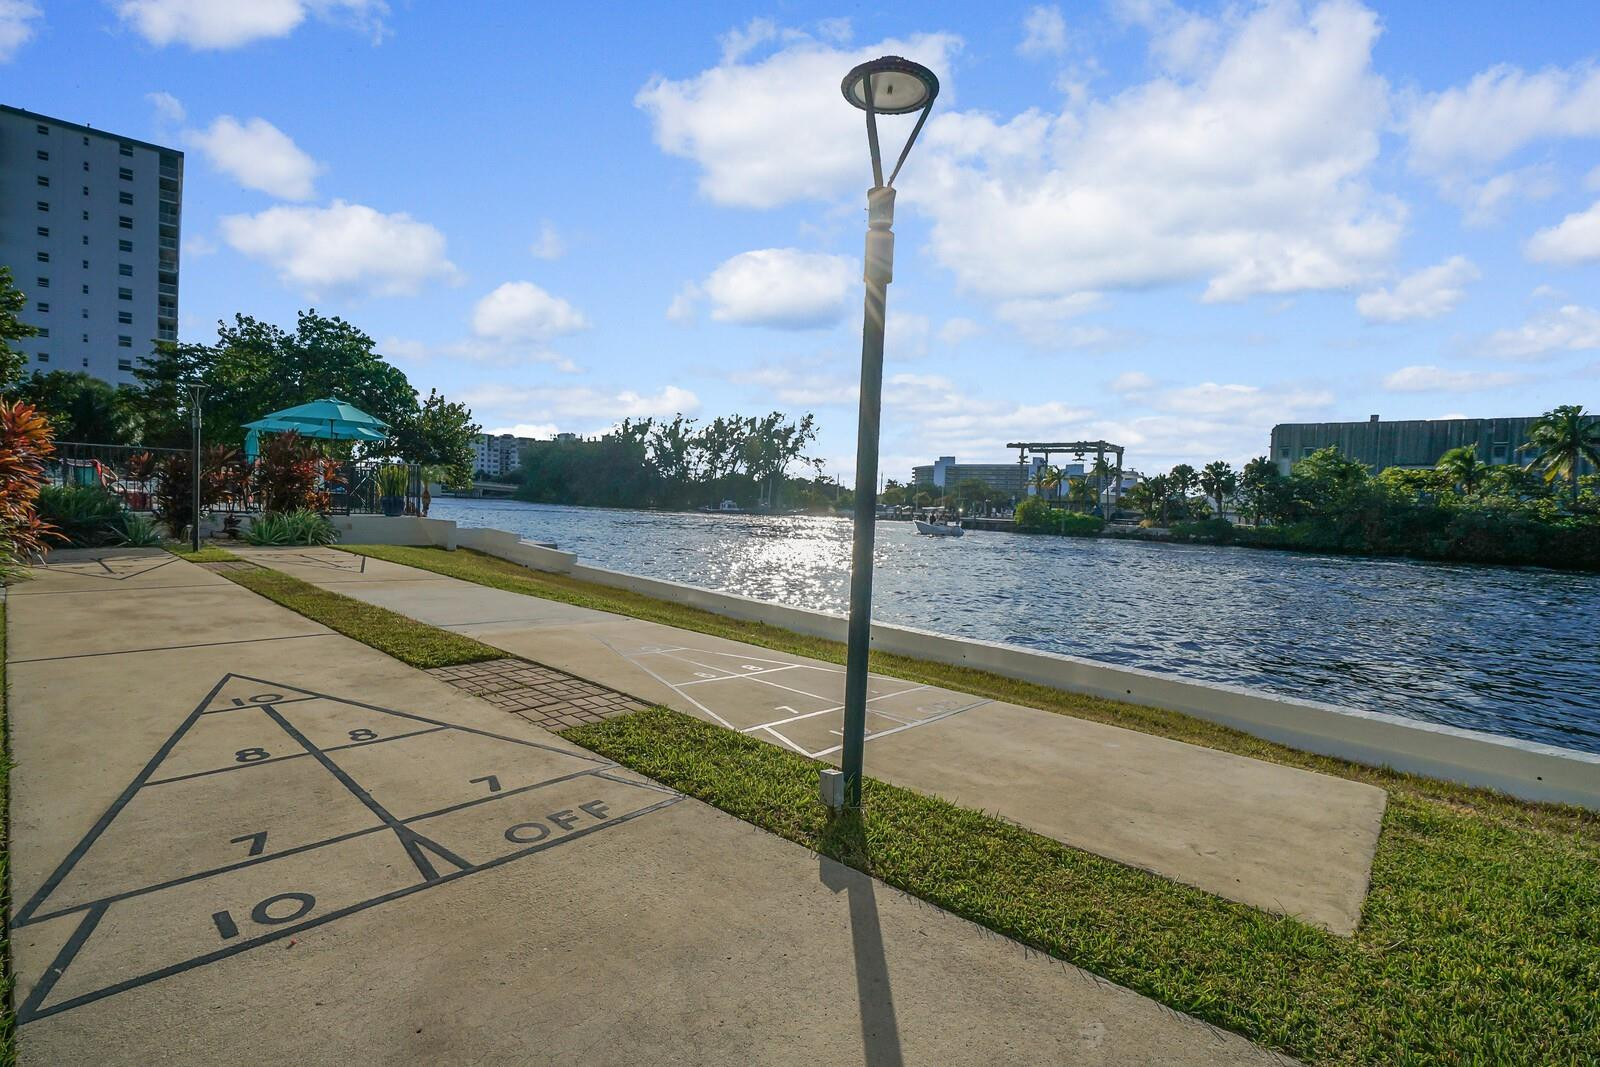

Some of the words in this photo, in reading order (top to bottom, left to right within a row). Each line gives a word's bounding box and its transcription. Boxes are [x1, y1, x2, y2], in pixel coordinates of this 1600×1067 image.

[231, 693, 285, 707] 10
[348, 728, 379, 742] 8
[235, 747, 272, 763] 8
[469, 774, 502, 793] 7
[504, 799, 610, 844] OFF
[229, 831, 268, 857] 7
[211, 892, 317, 940] 10
